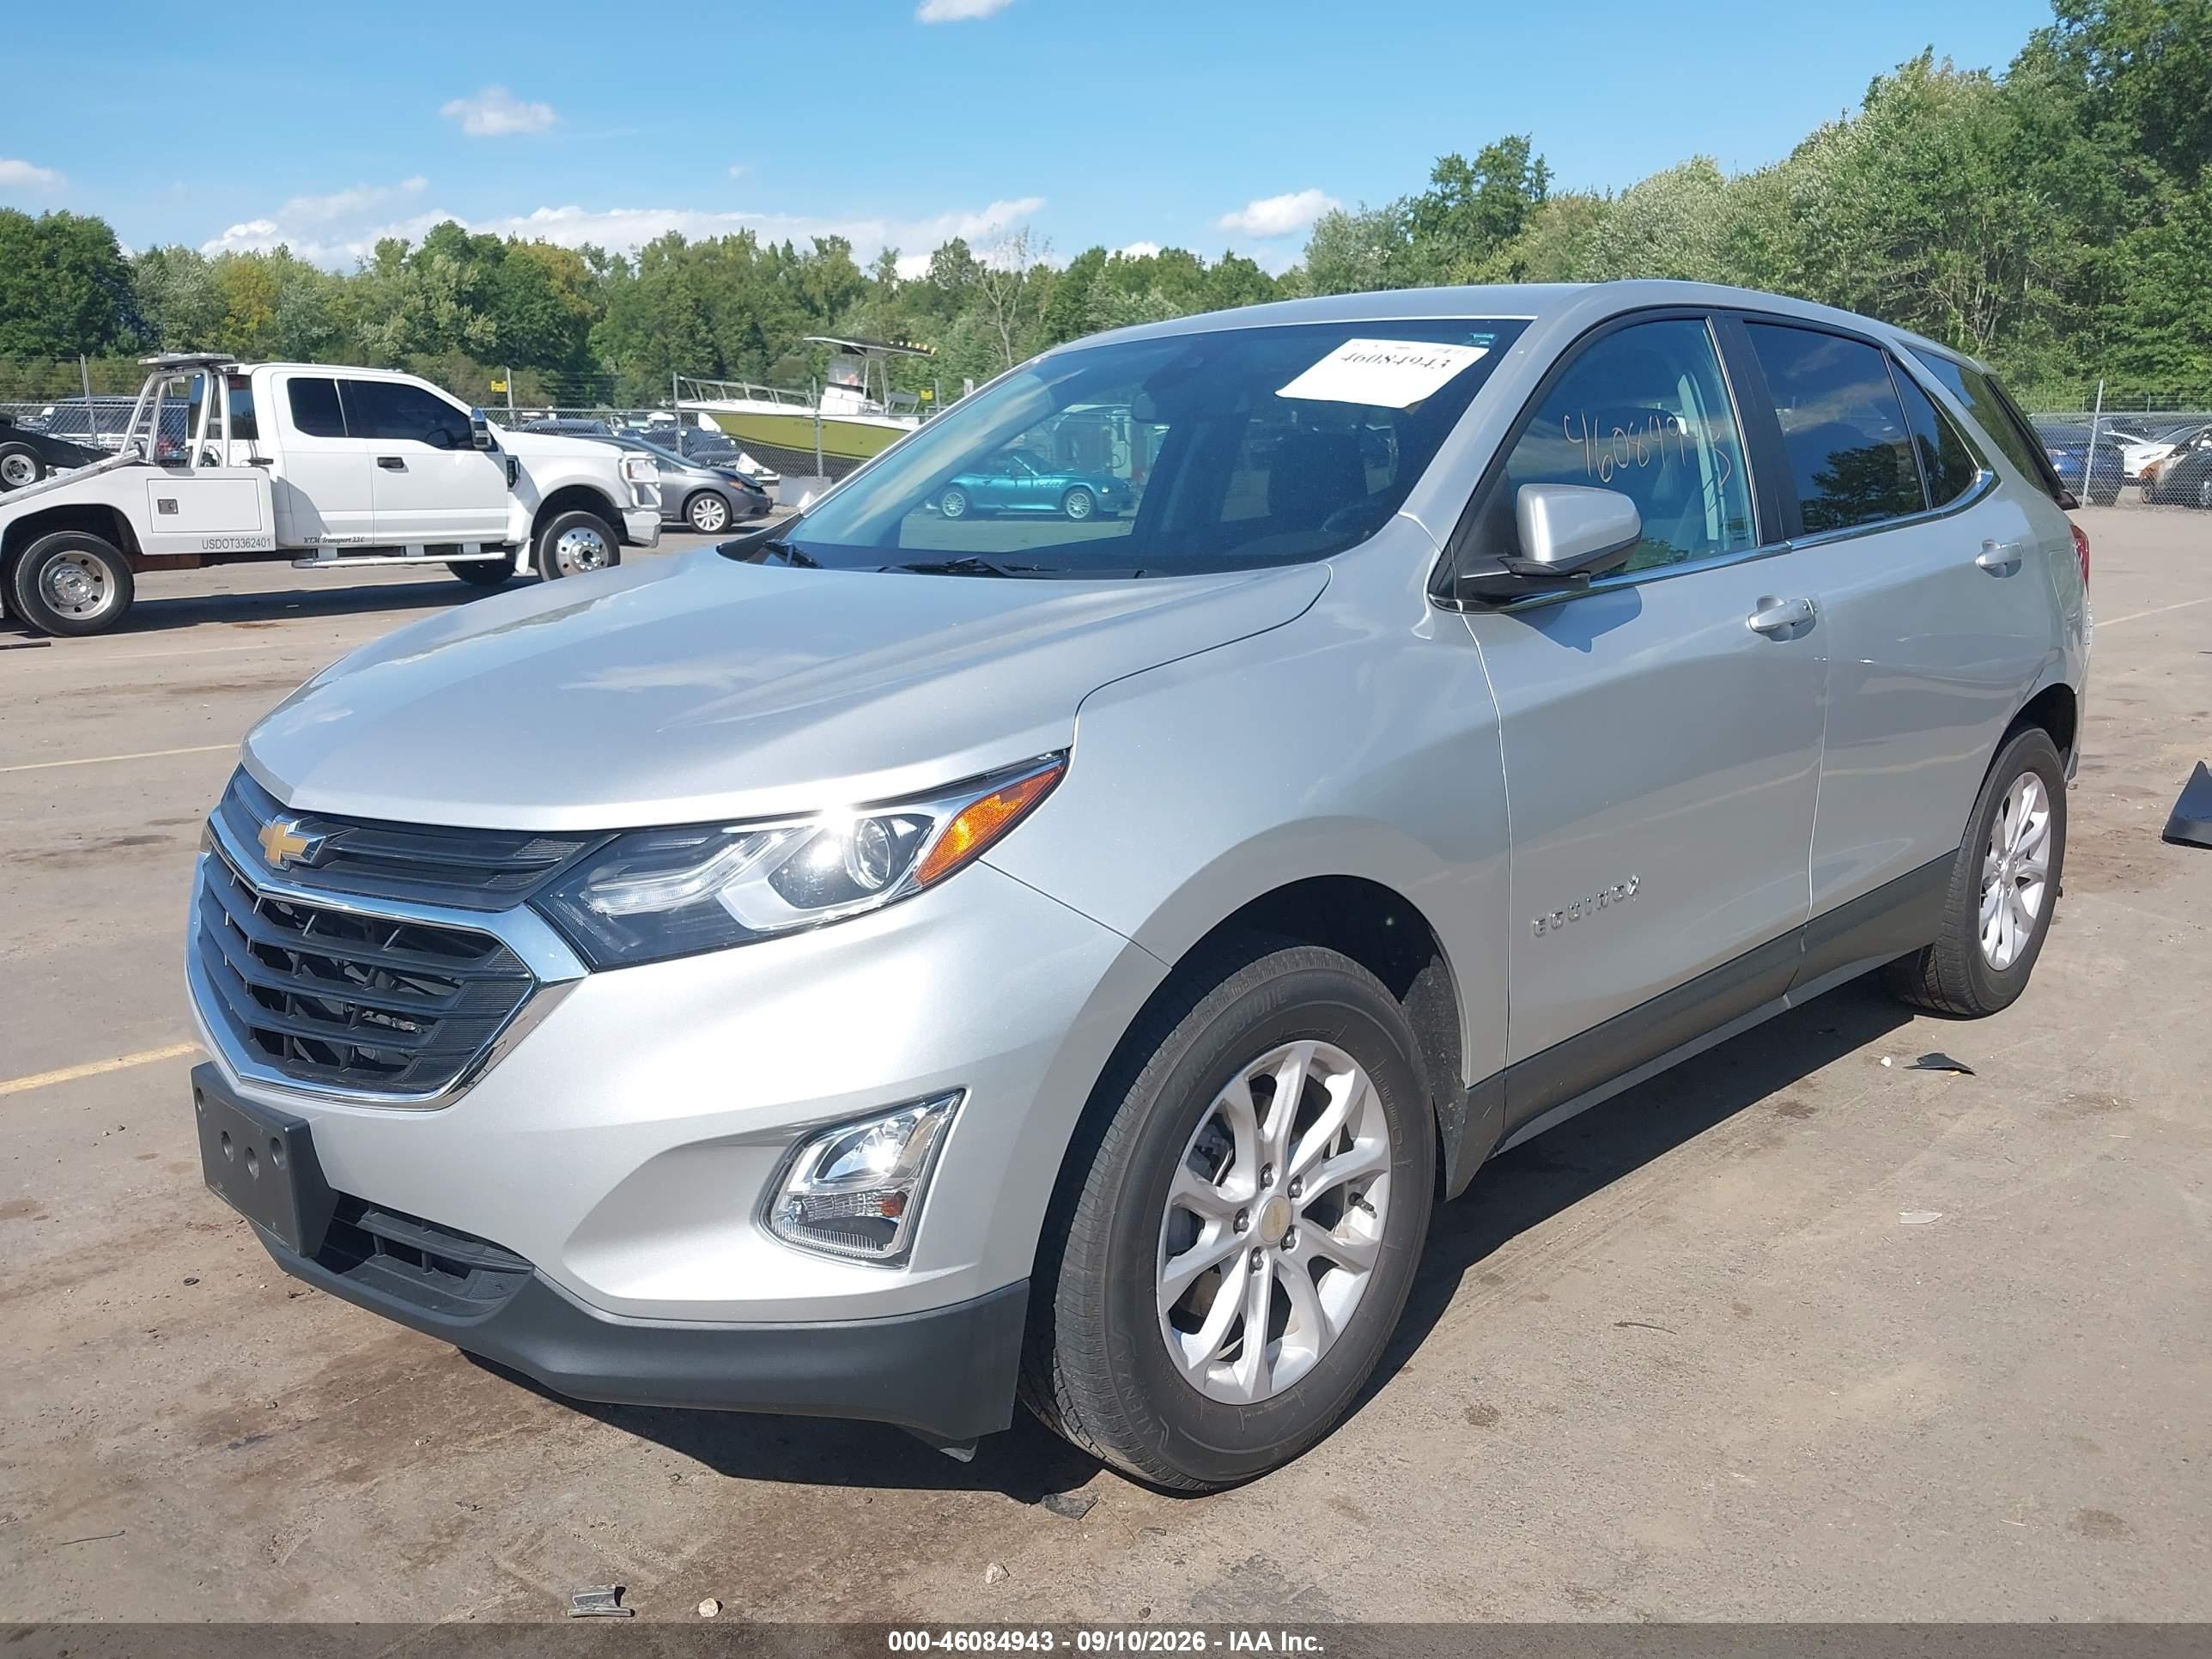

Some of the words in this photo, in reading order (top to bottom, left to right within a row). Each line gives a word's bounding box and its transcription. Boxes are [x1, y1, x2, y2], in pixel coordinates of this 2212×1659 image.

[201, 537, 271, 550] USDOT3362401
[321, 536, 351, 547] Transport
[1112, 1350, 1159, 1436] ALENZA
